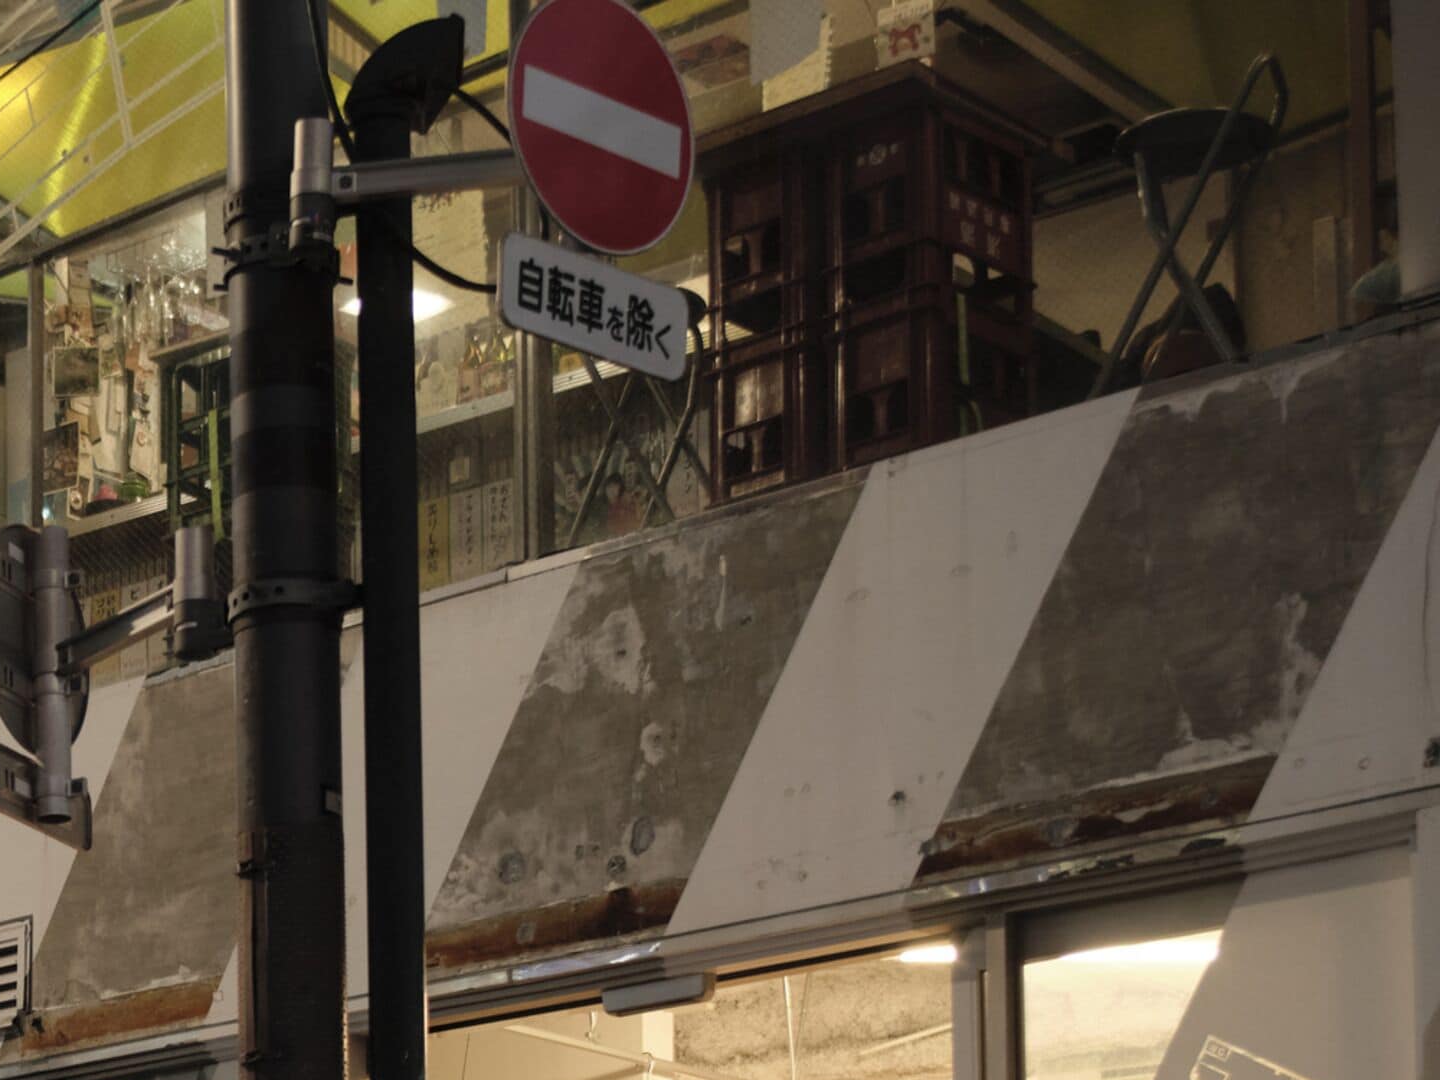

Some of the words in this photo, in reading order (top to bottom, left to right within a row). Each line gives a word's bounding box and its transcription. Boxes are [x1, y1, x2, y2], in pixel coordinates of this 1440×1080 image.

[517, 257, 671, 360] 自転車を除く
